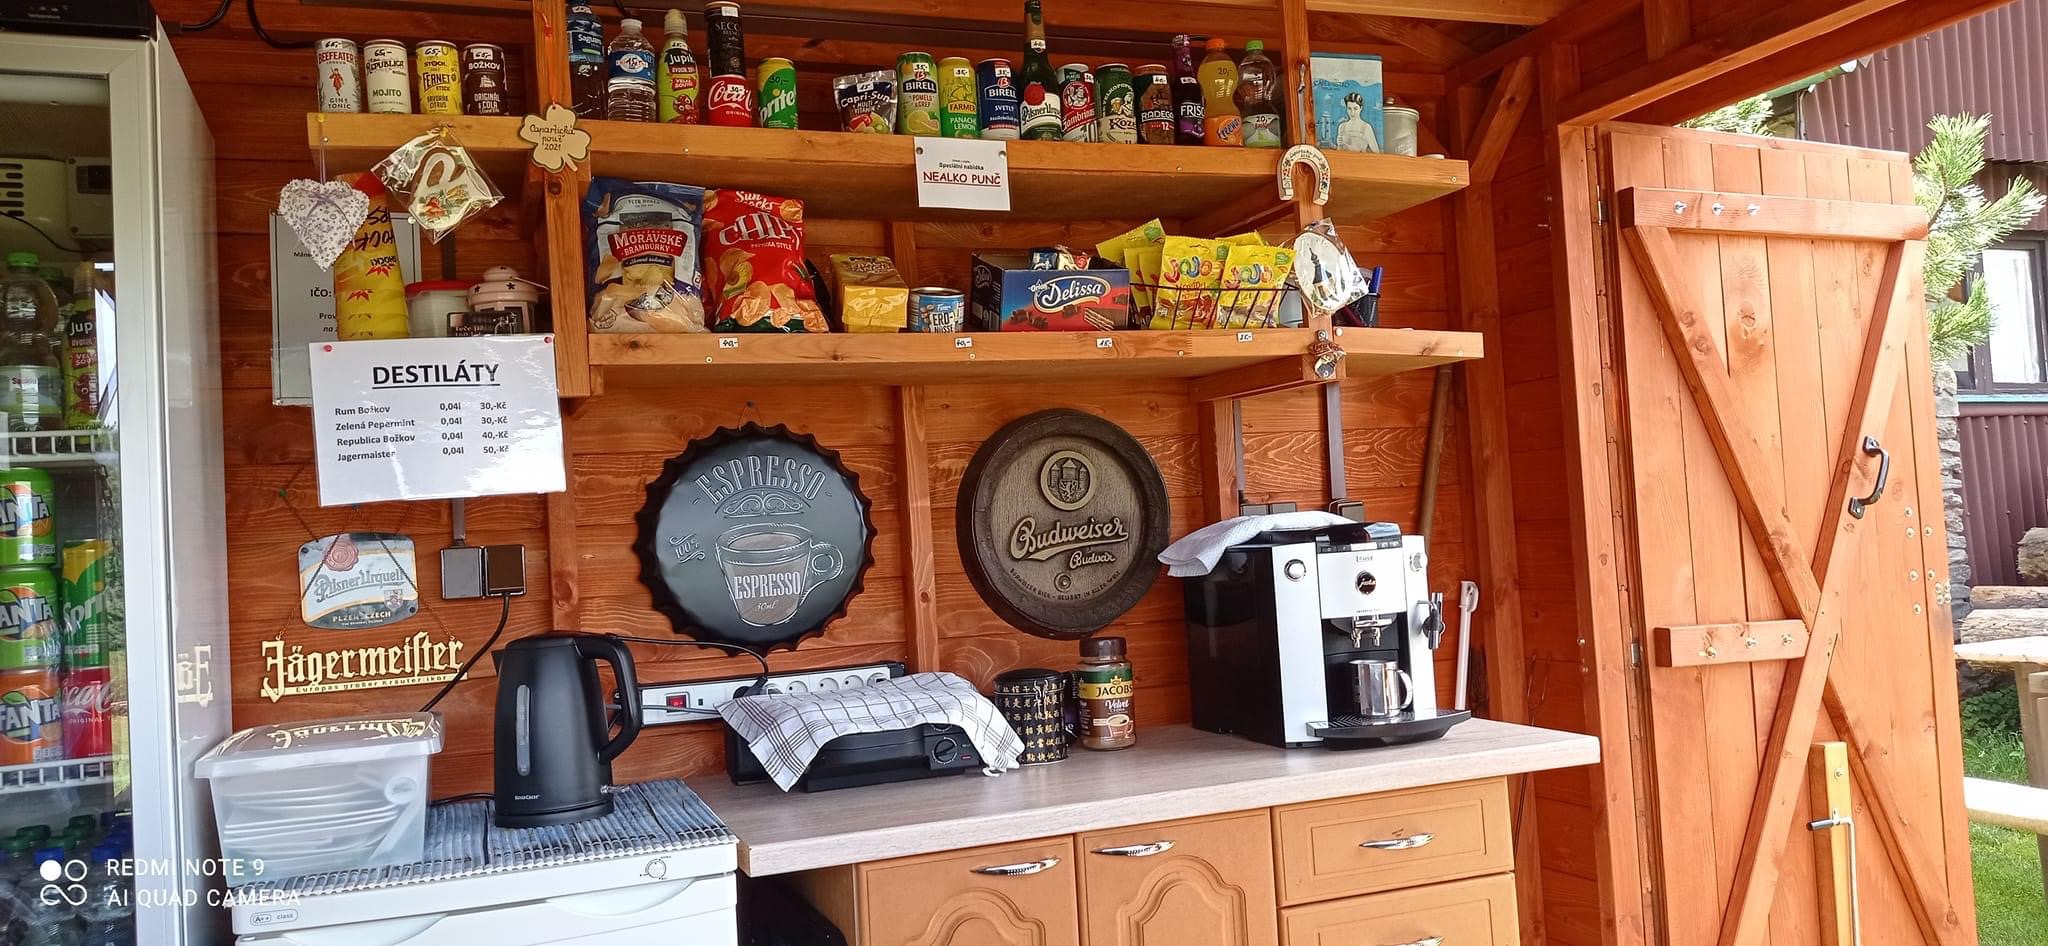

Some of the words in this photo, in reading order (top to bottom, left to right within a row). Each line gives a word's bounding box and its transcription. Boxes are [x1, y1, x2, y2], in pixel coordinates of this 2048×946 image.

[319, 51, 354, 64] BEEFEATER
[469, 61, 500, 70] BOŽKOV
[423, 72, 450, 90] FERNET
[905, 81, 936, 91] BIRELL
[372, 89, 402, 97] MOJITO
[841, 91, 890, 108] Capri-Sun
[988, 89, 1016, 99] BIRELL
[759, 89, 797, 126] prite
[1161, 122, 1170, 131] 12
[923, 171, 968, 183] NEALKO
[972, 173, 1001, 185] PUNČ
[614, 232, 683, 250] MORAVSKÉ
[310, 286, 332, 297] IČO:
[1042, 280, 1102, 306] Delissa
[319, 312, 336, 320] Prov
[69, 321, 95, 336] Jup
[372, 360, 500, 385] DESTILÁTY
[335, 407, 356, 416] Rum
[440, 402, 462, 411] 0,04l
[480, 401, 507, 411] 30,-Kč
[336, 421, 366, 431] Zelená
[368, 419, 415, 430] Pepermint
[440, 417, 463, 426] 0,04l
[481, 415, 508, 425] 30,-Kč
[337, 436, 381, 447] Republica
[383, 432, 416, 444] Božkov
[442, 432, 464, 441] 0,04l
[482, 430, 509, 440] 40,-Kč
[442, 446, 465, 456] 0,04l
[483, 445, 509, 455] 50,-Kč
[695, 455, 827, 505] ESPRESSO
[1011, 516, 1128, 560] Budweiser
[673, 537, 700, 559] 100%
[1070, 551, 1116, 570] Budvar
[314, 572, 360, 604] Pilsner
[359, 569, 404, 588] Urquell
[733, 571, 801, 600] ESPRESSO
[0, 597, 55, 627] ANTA
[365, 610, 392, 619] CZECH
[1096, 686, 1133, 698] JACOBS
[1105, 700, 1130, 711] Velvet
